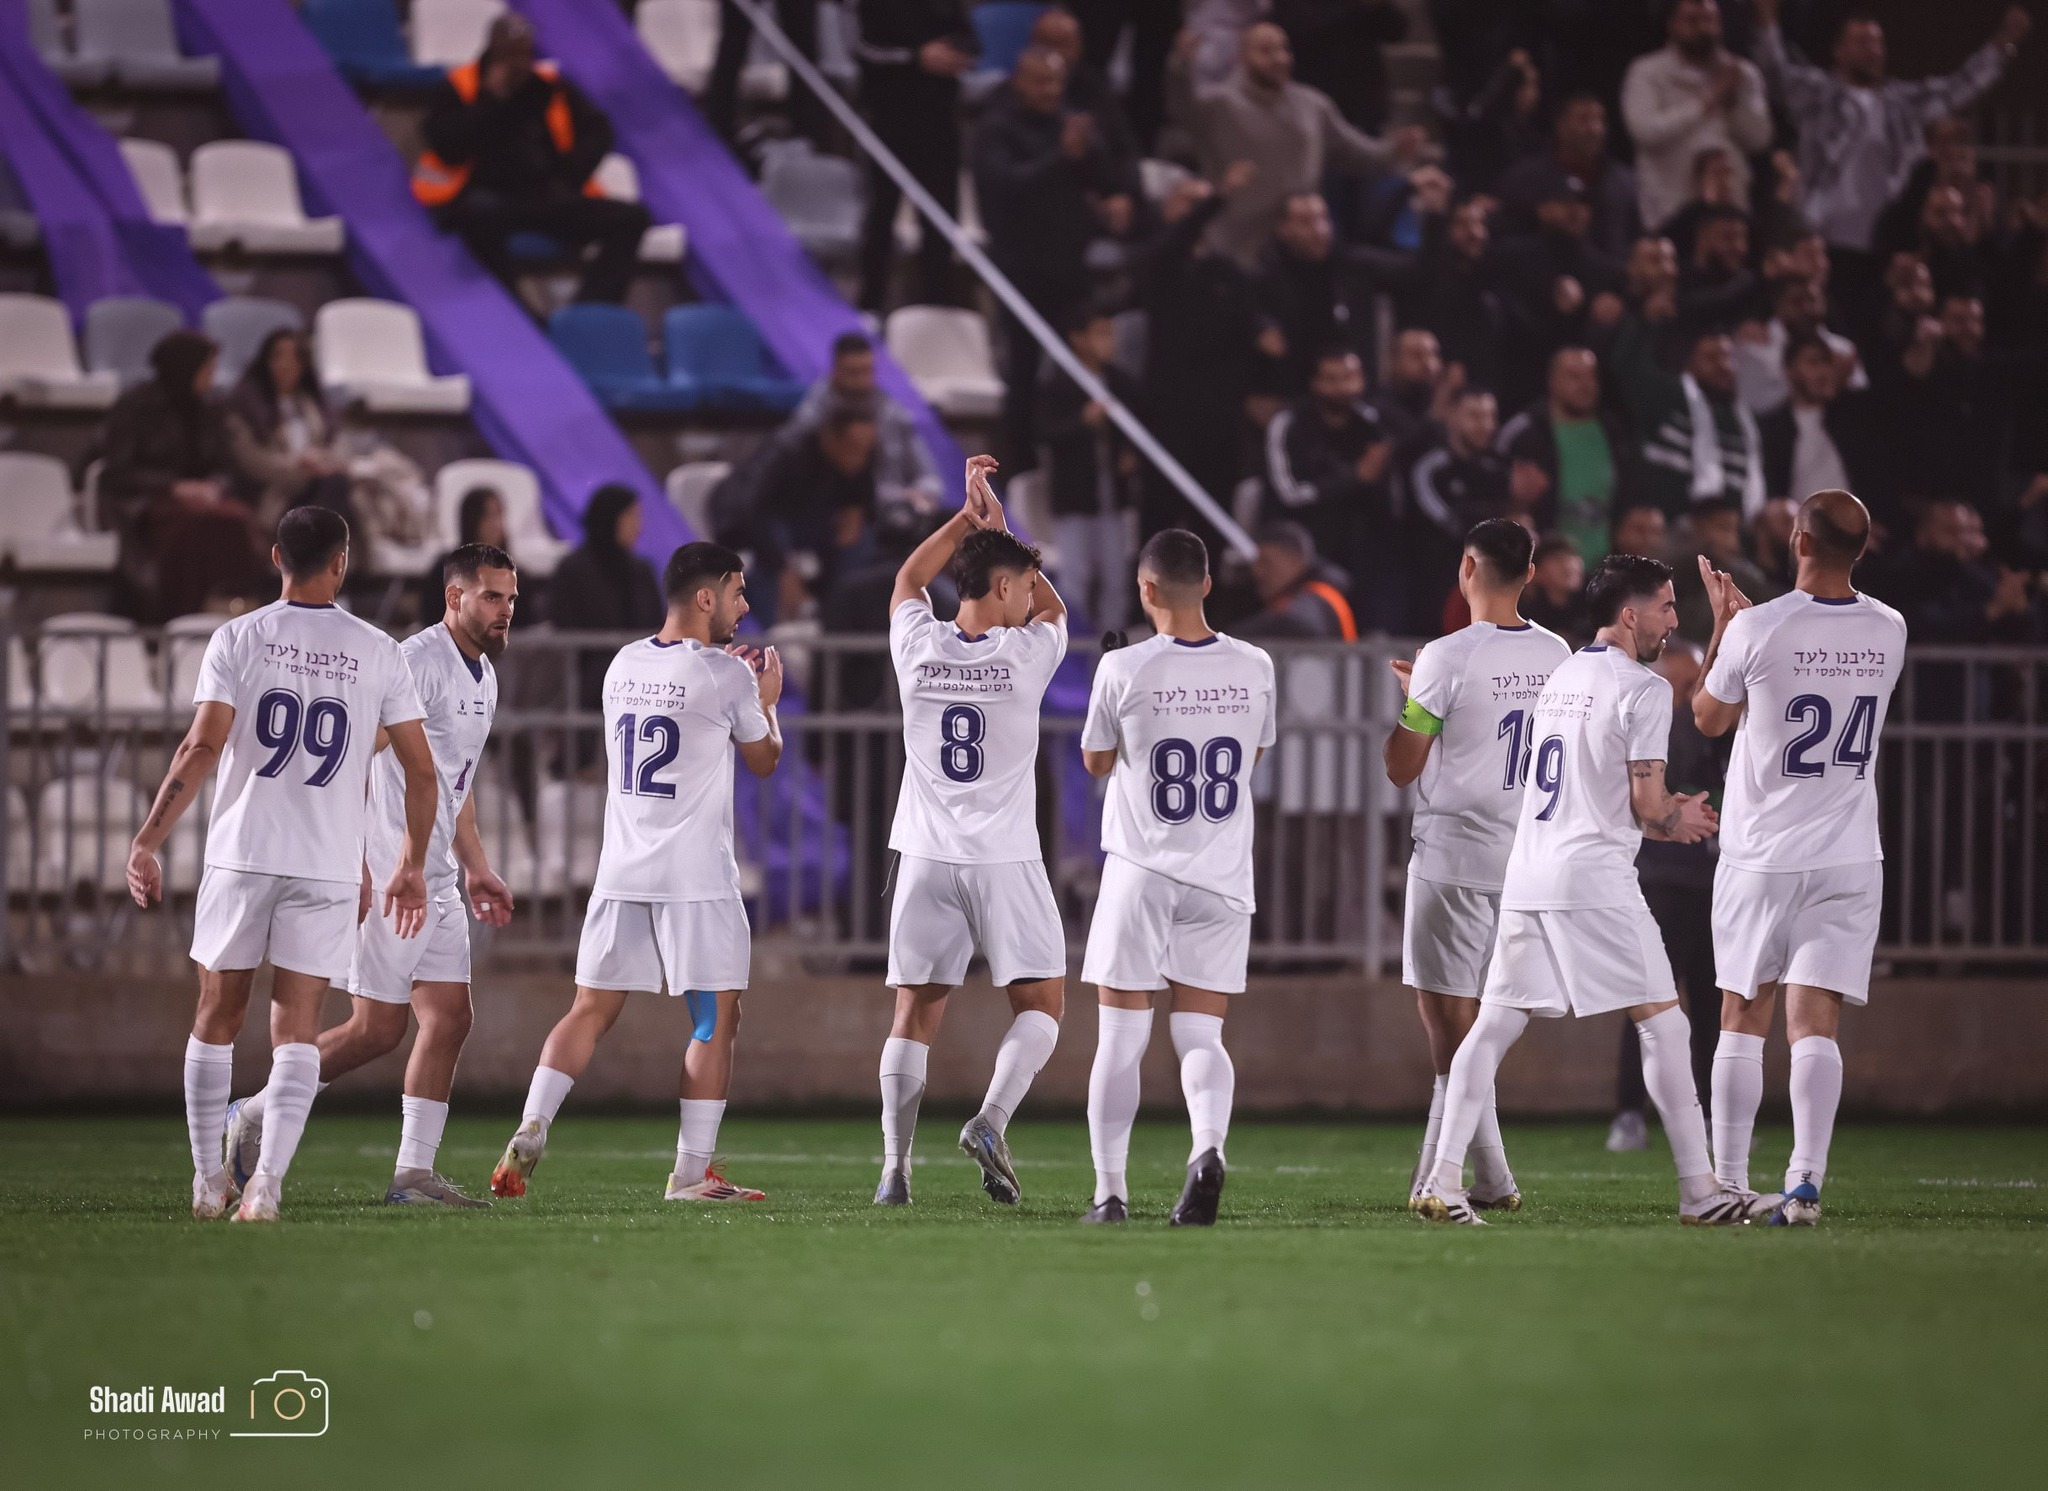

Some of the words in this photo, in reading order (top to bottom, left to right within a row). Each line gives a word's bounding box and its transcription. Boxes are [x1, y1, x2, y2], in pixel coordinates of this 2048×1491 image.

[265, 643, 300, 660] לעד
[1794, 648, 1827, 664] לעד
[1836, 648, 1885, 665] בליבנו
[306, 652, 359, 672] בליבנו
[285, 663, 320, 678] אלפסי
[326, 669, 357, 685] ניסים
[919, 664, 951, 679] לעד
[959, 665, 1011, 681] בליבנו
[1815, 666, 1851, 677] אלפסי
[1856, 667, 1884, 678] ניסים
[938, 681, 974, 692] אלפסי
[979, 682, 1013, 692] ניסים
[1492, 671, 1520, 689] לעד
[641, 681, 686, 698] בליבנו
[1152, 686, 1187, 703] לעד
[1195, 684, 1249, 702] בליבנו
[1511, 688, 1539, 700] אלפסי
[655, 699, 685, 710] ניסים
[1175, 704, 1212, 715] אלפסי
[1217, 704, 1250, 714] ניסים
[255, 687, 352, 788] 99
[940, 702, 986, 783] 8
[1782, 693, 1878, 780] 24
[614, 712, 681, 800] 12
[1150, 735, 1242, 826] 88
[1534, 734, 1566, 822] 9
